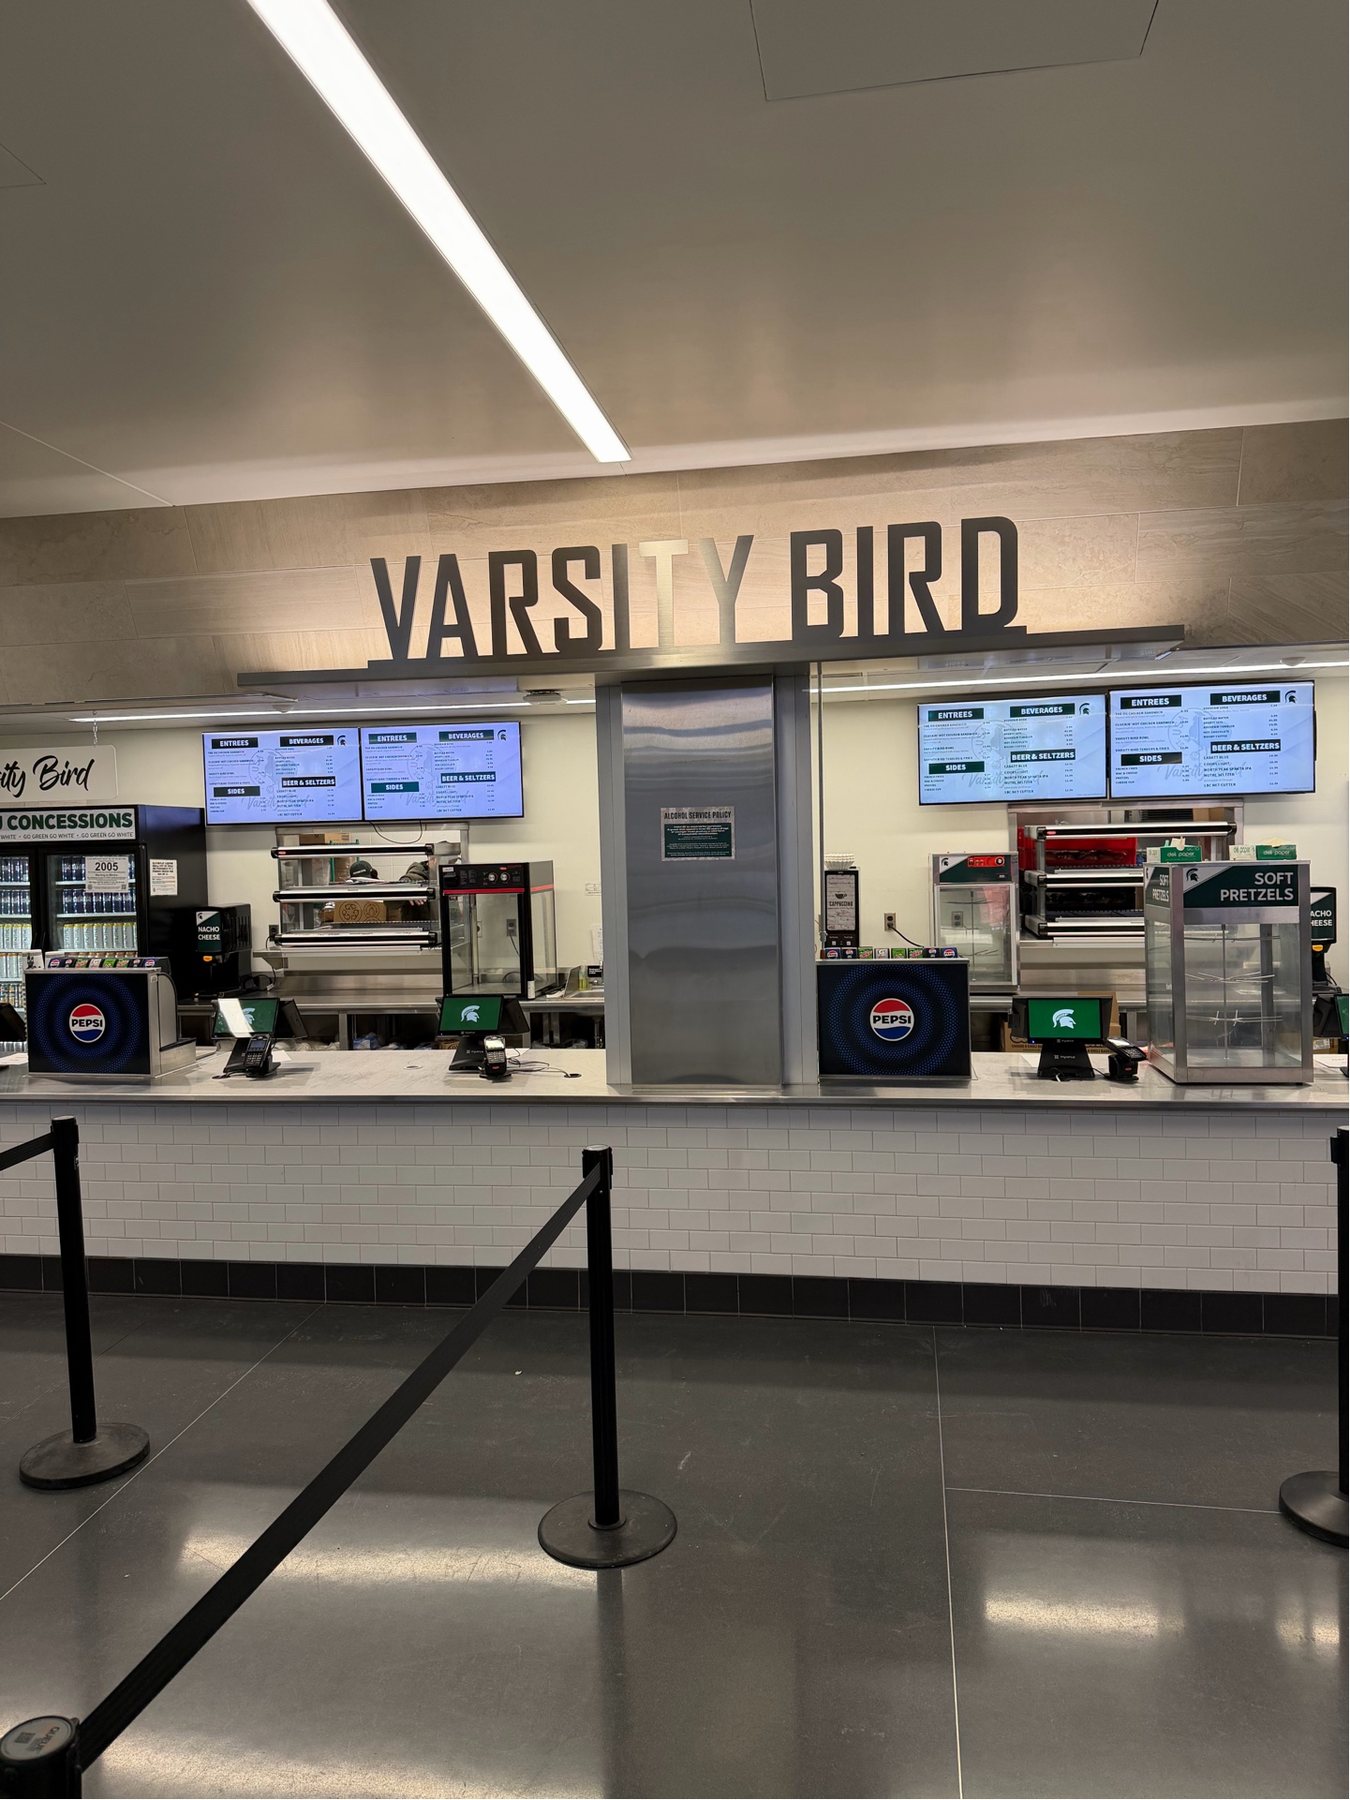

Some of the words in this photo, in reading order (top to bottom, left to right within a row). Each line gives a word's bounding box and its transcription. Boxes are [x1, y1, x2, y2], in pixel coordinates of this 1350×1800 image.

[370, 535, 754, 660] VARSITY
[790, 516, 1017, 641] BIRD
[1131, 698, 1170, 707] ENTREES
[1221, 694, 1267, 703] BEVERAGES
[938, 711, 973, 719] ENTREES
[1021, 706, 1063, 715] BEVERAGES
[377, 734, 408, 742] ENTREES
[219, 739, 249, 747] ENTREES
[1212, 744, 1233, 752] BEER
[1241, 742, 1280, 751] SELTZERS
[1011, 753, 1031, 761] BEER
[1038, 751, 1075, 760] SELTZERS
[0, 760, 26, 798] ity
[33, 755, 95, 791] Bird
[304, 778, 335, 786] SELTZERS
[689, 811, 711, 819] SERVICE
[712, 811, 731, 819] POLICY
[7, 812, 133, 830] CONCESSIONS
[95, 862, 119, 871] 2005
[1160, 874, 1169, 886] SOFT
[1255, 872, 1294, 885] SOFT
[1220, 888, 1294, 901] PRETZELS
[1311, 919, 1333, 927] HEESE
[71, 1018, 103, 1028] PEPSI
[873, 1015, 912, 1024] PEPSI
